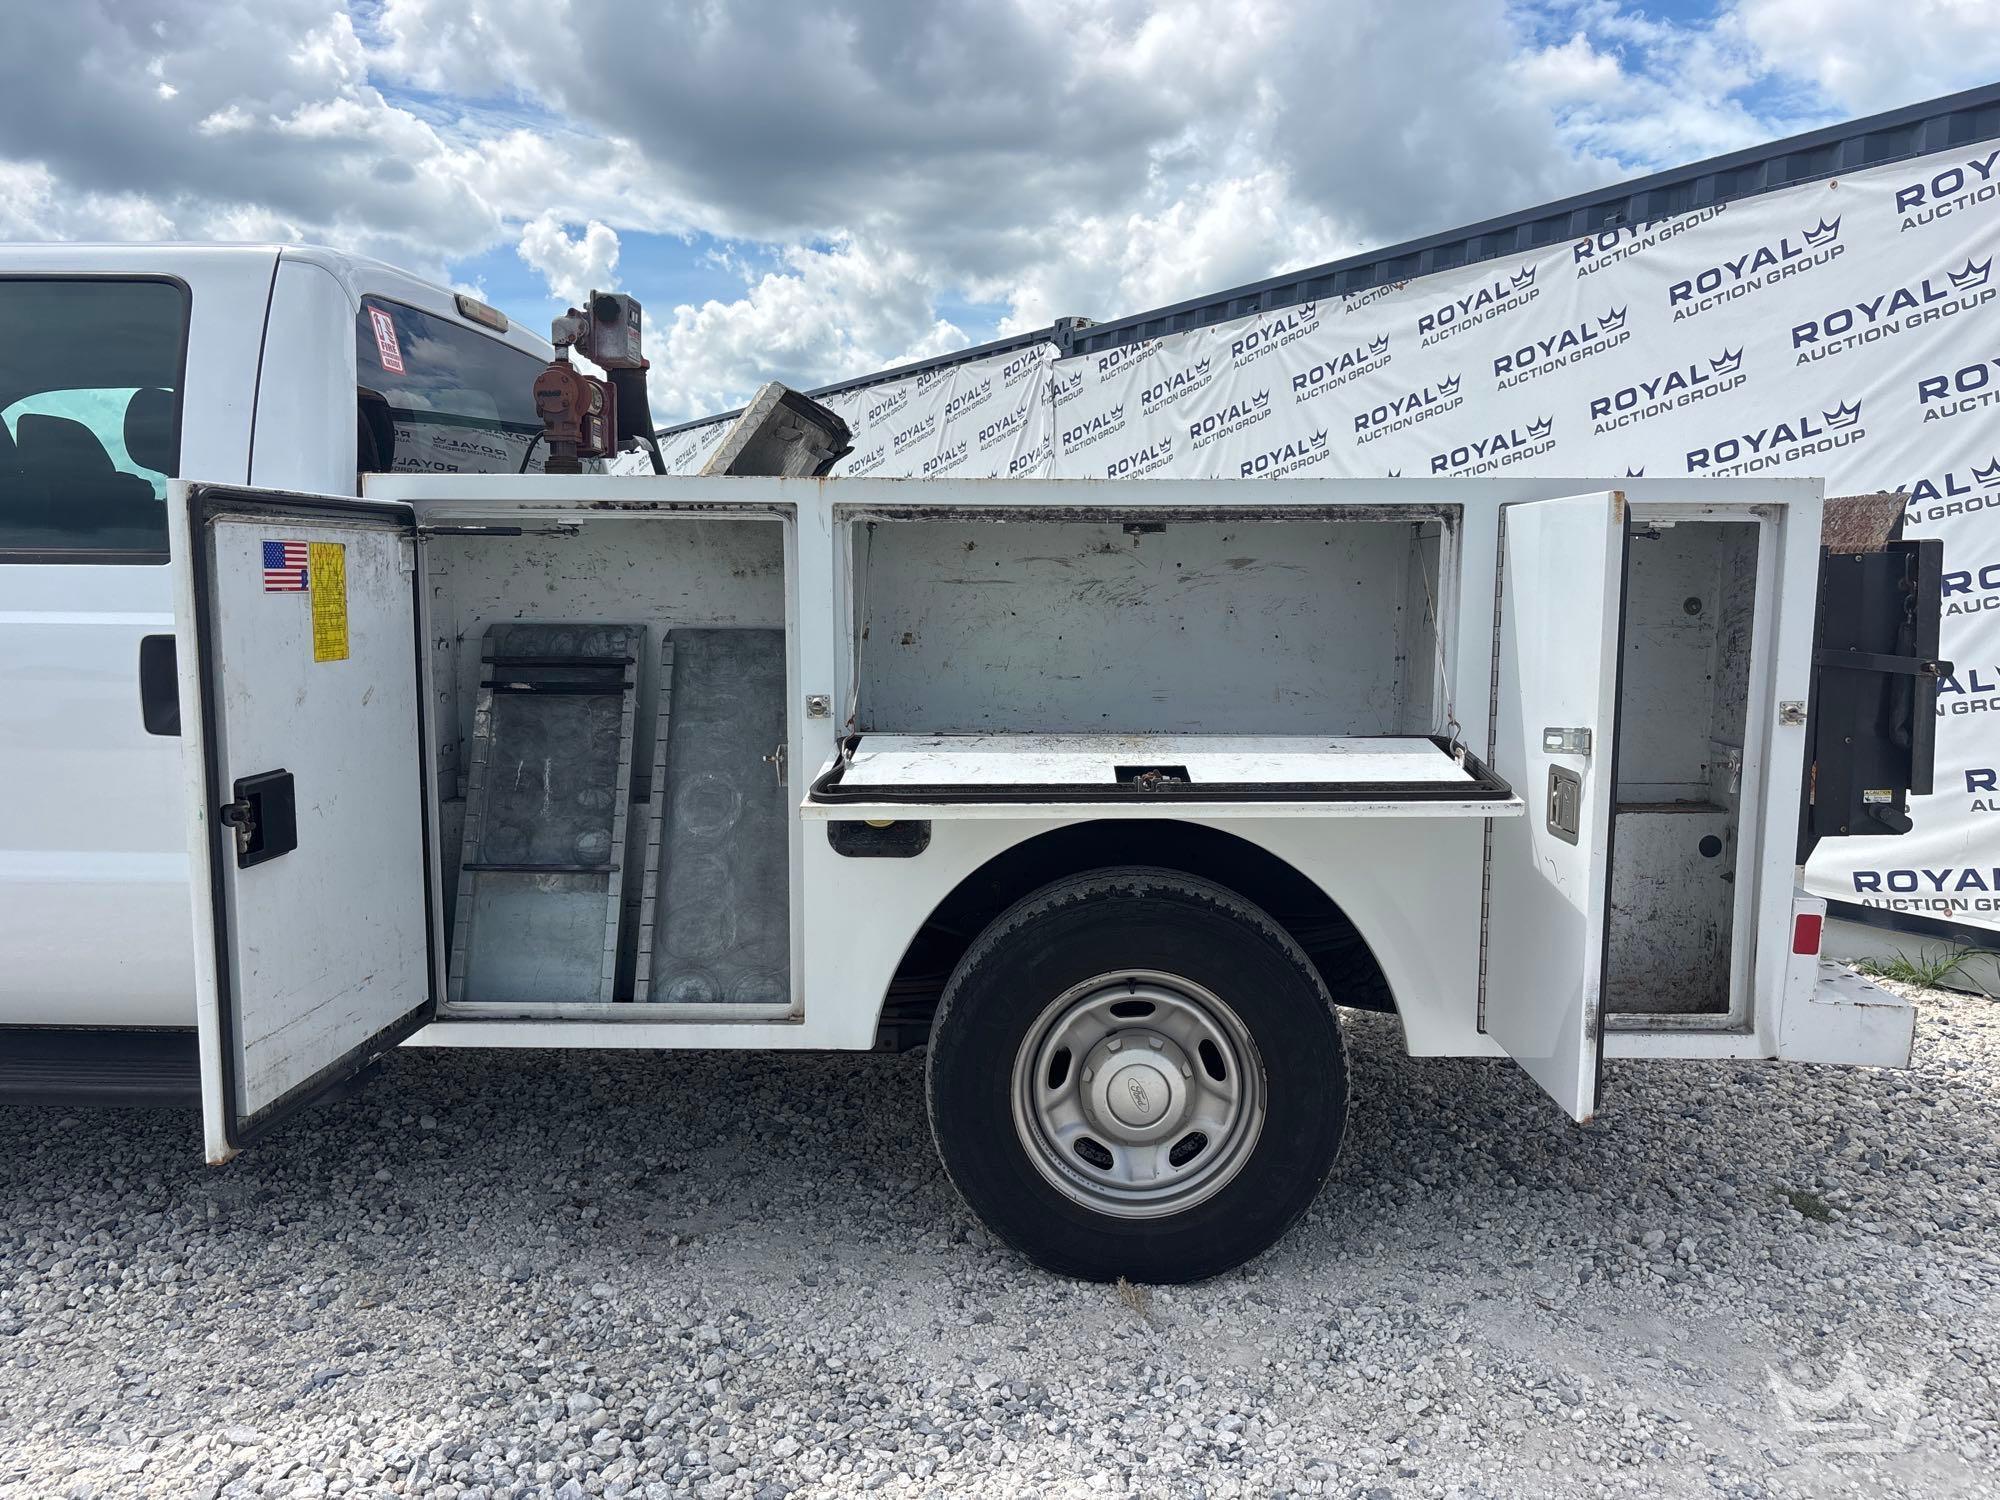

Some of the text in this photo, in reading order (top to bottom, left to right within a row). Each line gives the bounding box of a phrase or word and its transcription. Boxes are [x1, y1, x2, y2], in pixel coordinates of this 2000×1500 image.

[1900, 181, 2000, 233] AUCTIO
[1577, 204, 1728, 279] AUCTION GROUP
[1669, 238, 1803, 306] ROYAL
[1673, 244, 1845, 323] AUCTION GROUP
[1418, 281, 1511, 335] ROYAL
[1421, 288, 1540, 349] AUCTION GROUP
[1791, 279, 1948, 349] ROYAL
[1796, 287, 1997, 367] AUCTION GROUP
[381, 341, 398, 355] FIRE
[1231, 314, 1300, 359] ROYAL
[1233, 320, 1320, 370] AUCTION GROUP
[1493, 323, 1598, 377] ROYAL
[1003, 347, 1044, 380] ROYAL
[1005, 368, 1033, 389] AUCTION
[1100, 341, 1164, 384] AUCTION GROUP
[1292, 347, 1369, 392] ROYAL
[1295, 354, 1392, 404] AUCTION GROUP
[1497, 331, 1631, 391] AUCTION GROUP
[918, 379, 942, 397] AUCTION
[945, 386, 982, 417] ROYAL
[1058, 387, 1084, 409] GROUP
[1141, 368, 1195, 406] ROYAL
[1142, 374, 1212, 417] AUCTION GROUP
[1590, 364, 1710, 421] ROYAL
[1593, 373, 1747, 436] AUCTION GROUP
[869, 394, 899, 421] ROYAL
[870, 412, 890, 429] AUCTION
[946, 392, 992, 425] AUCTION GROUP
[1189, 400, 1253, 440] ROYAL
[1354, 387, 1438, 433] ROYAL
[1356, 396, 1464, 446] AUCTION GROUP
[894, 421, 926, 448] ROYAL
[895, 438, 916, 456] AUCTION
[978, 413, 1018, 444] ROYAL
[980, 419, 1029, 452] AUCTION GROUP
[1062, 413, 1111, 446] ROYAL
[1064, 420, 1126, 456] AUCTION GROUP
[1192, 408, 1272, 451] AUCTION GROUP
[1686, 416, 1823, 473] ROYAL
[1785, 429, 1866, 462] GROUP
[848, 451, 877, 475] ROYAL
[923, 446, 958, 474] ROYAL
[948, 454, 969, 470] GROUP
[1107, 445, 1160, 479] ROYAL
[1145, 454, 1174, 474] GROUP
[1240, 440, 1310, 479] ROYAL
[1290, 449, 1330, 472] GROUP
[1430, 429, 1527, 475] ROYAL
[1501, 439, 1556, 466] GROUP
[1130, 1085, 1147, 1108] Ford
